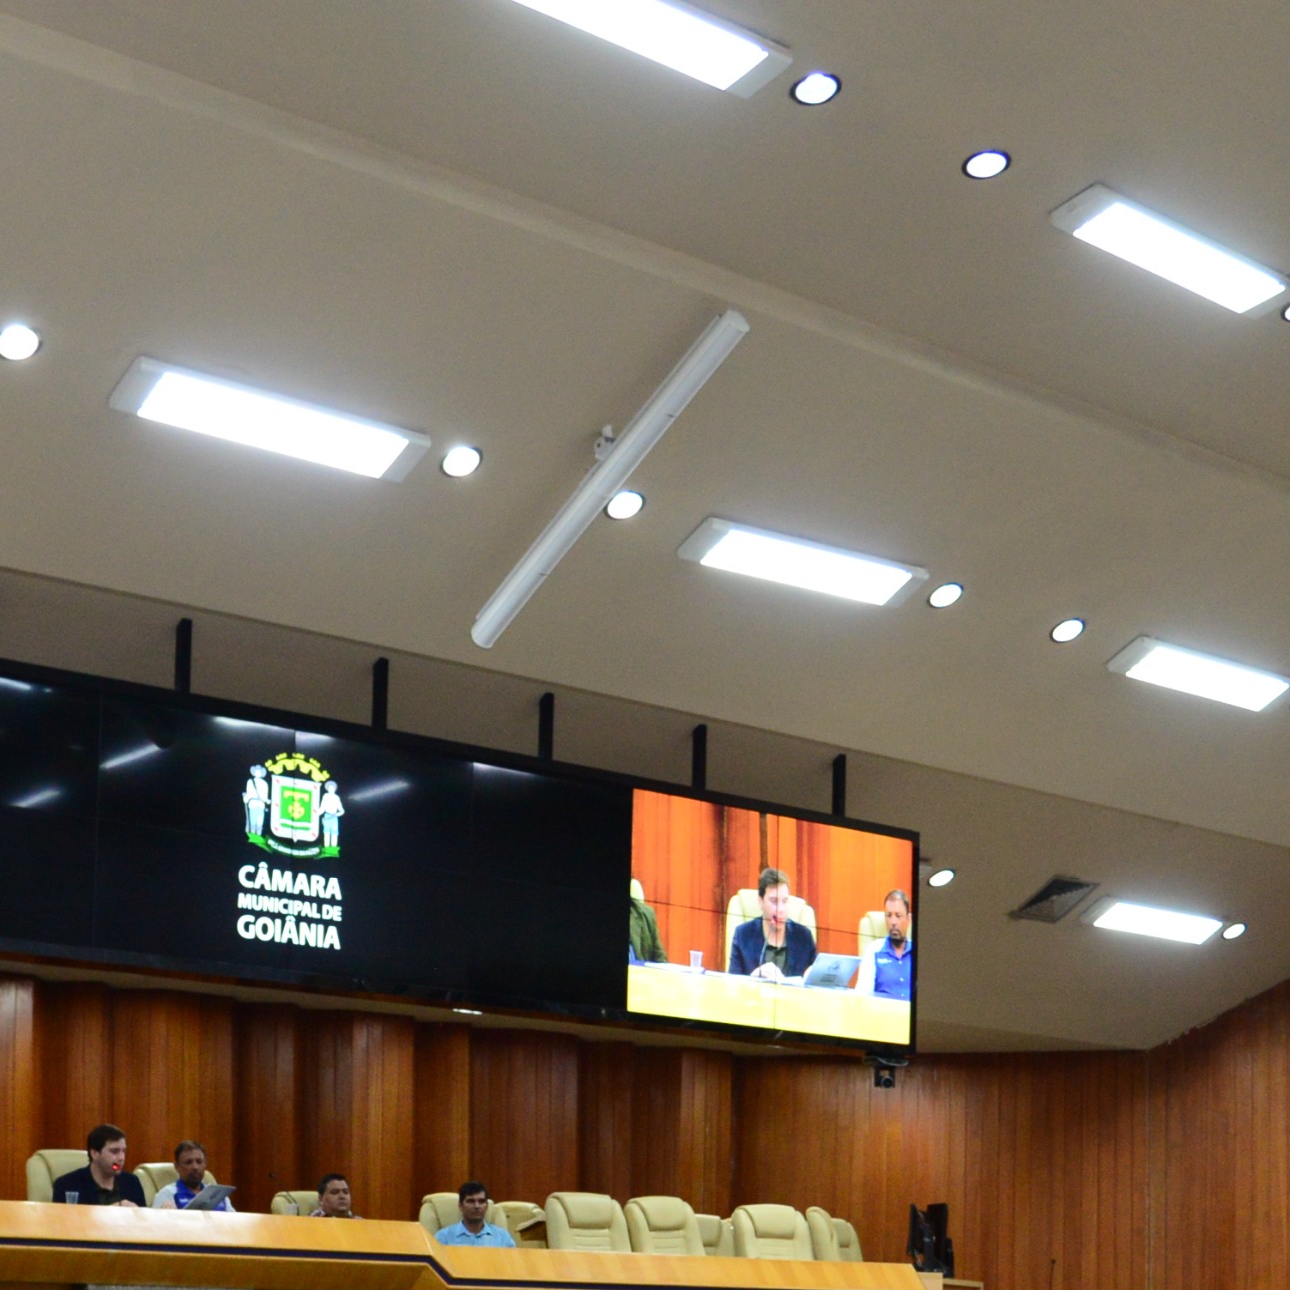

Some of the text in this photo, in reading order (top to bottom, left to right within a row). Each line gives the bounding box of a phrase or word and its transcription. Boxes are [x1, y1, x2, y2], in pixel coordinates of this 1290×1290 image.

[238, 861, 342, 901] CÂMARA
[237, 893, 342, 922] MUNICIPAL DE
[236, 914, 342, 950] GOIÂNIA
